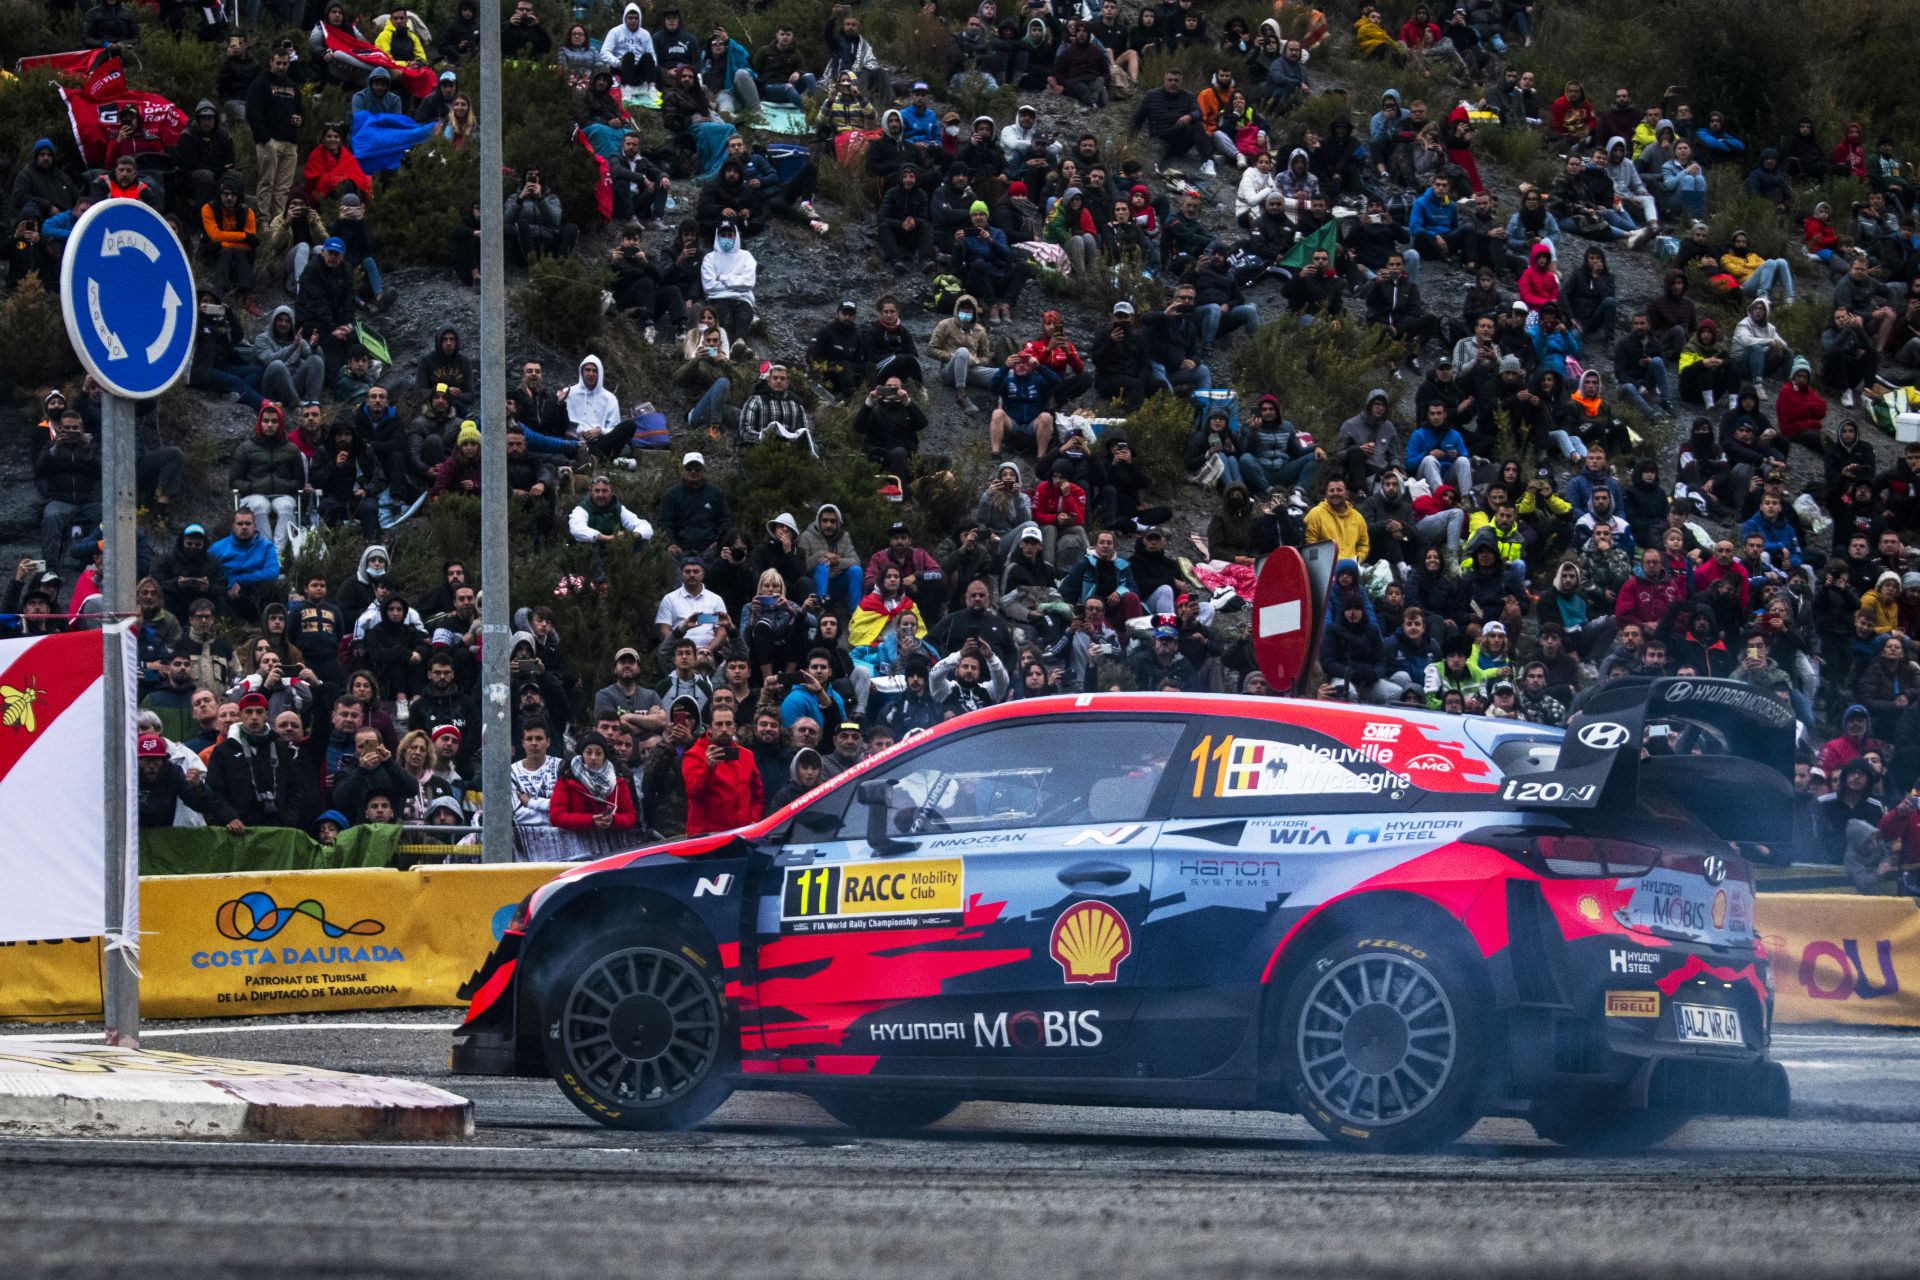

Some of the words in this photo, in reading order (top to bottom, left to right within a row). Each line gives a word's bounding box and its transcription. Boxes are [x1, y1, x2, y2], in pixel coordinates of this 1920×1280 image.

[1362, 723, 1403, 740] OMP
[1297, 744, 1394, 764] Neuville
[790, 728, 934, 811] motorsport.hyundai.com
[1189, 734, 1235, 798] 11
[1299, 769, 1411, 794] Wydaeghe
[1386, 820, 1463, 830] HYUNDAI
[929, 832, 1028, 849] INNOCEAN
[1382, 830, 1437, 841] STEEL
[911, 869, 958, 886] Mobility
[1190, 878, 1270, 887] SYSTEMS
[796, 867, 830, 915] 11
[844, 873, 906, 903] RACC
[910, 887, 936, 900] Club
[1640, 879, 1682, 898] HYUNDAI
[1652, 895, 1705, 931] MOBIS
[812, 922, 826, 931] FIA
[826, 921, 847, 930] World
[848, 919, 867, 929] Rally
[868, 917, 918, 928] Championship
[191, 946, 277, 969] COSTA
[281, 945, 406, 965] DAURADA
[1627, 951, 1661, 963] HYUNDAI
[1628, 963, 1653, 974] STEEL
[217, 993, 231, 1003] DE
[234, 993, 248, 1003] LA
[311, 988, 325, 998] DE
[1607, 994, 1656, 1014] PIRELLI
[870, 1022, 966, 1041] HYUNDAI
[973, 1009, 1103, 1050] MOBIS
[1684, 1009, 1708, 1038] ALZ
[1708, 1011, 1725, 1039] WR
[1725, 1013, 1737, 1040] 49
